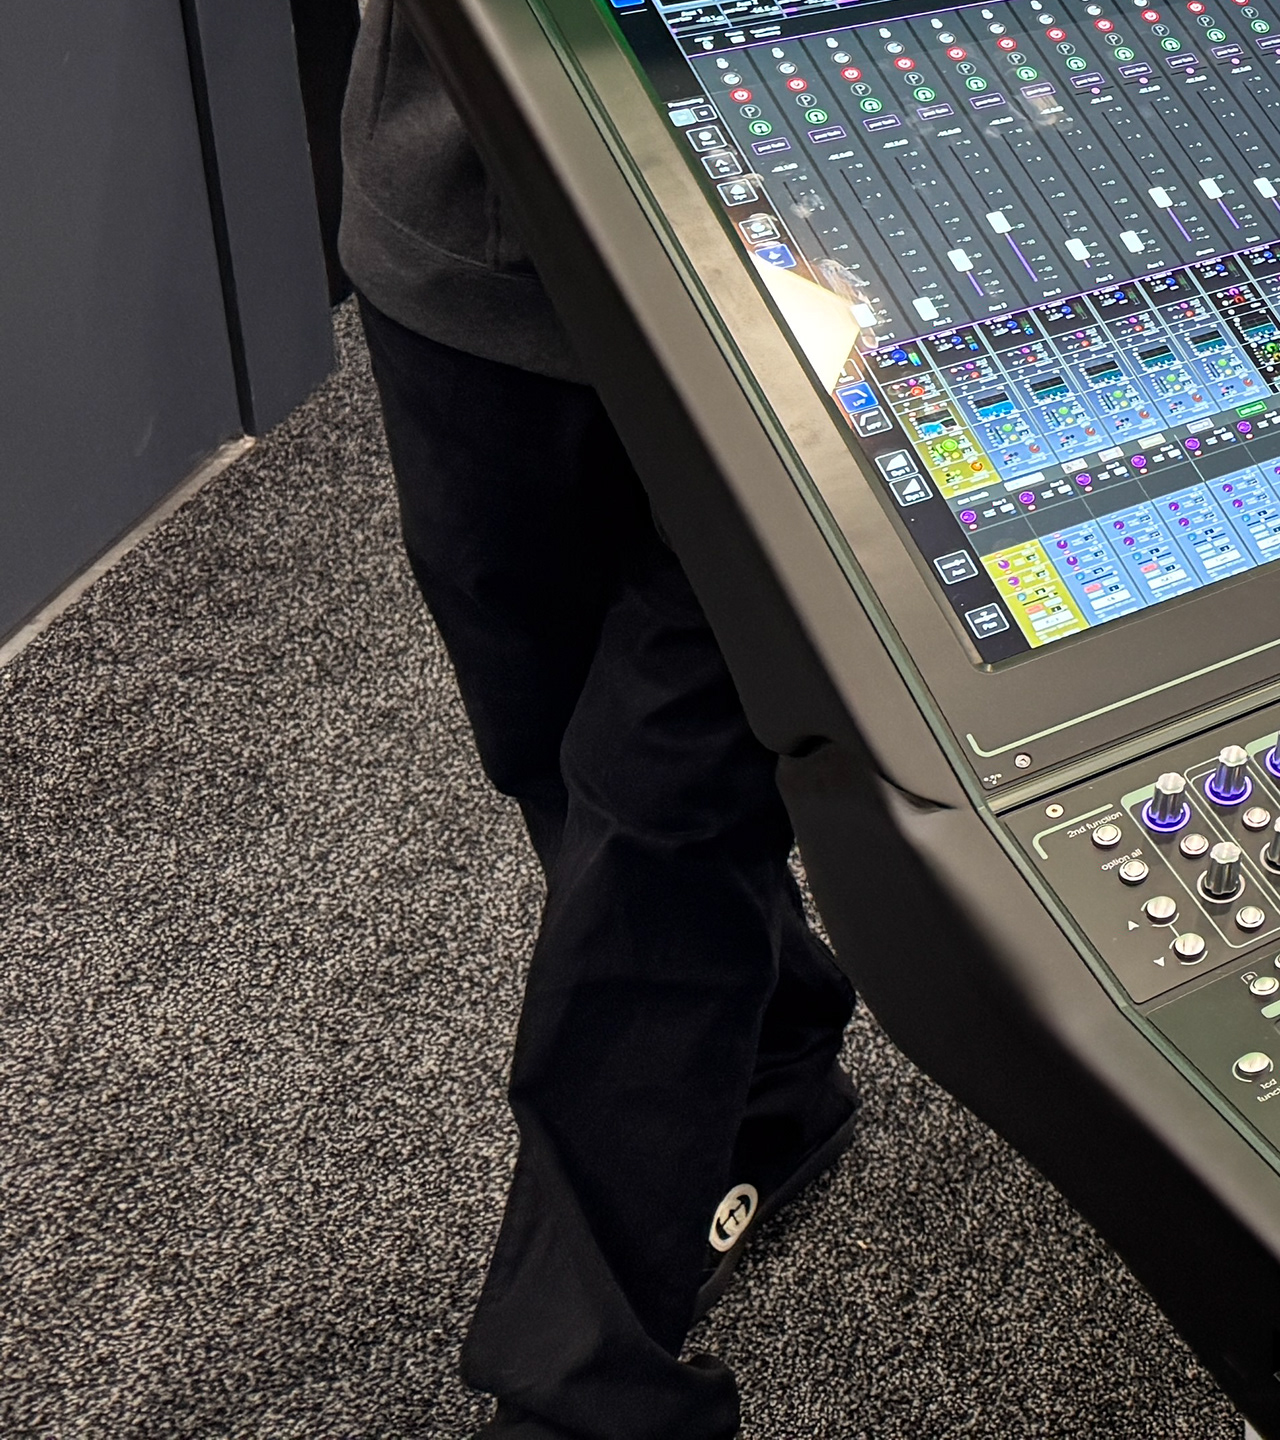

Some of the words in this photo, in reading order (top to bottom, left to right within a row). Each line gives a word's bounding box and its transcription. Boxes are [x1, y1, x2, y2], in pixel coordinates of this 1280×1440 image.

[1067, 825, 1087, 839] 2nd
[1086, 811, 1123, 830] function
[1101, 854, 1131, 872] option
[1130, 848, 1143, 859] all
[1260, 1078, 1278, 1090] lcd
